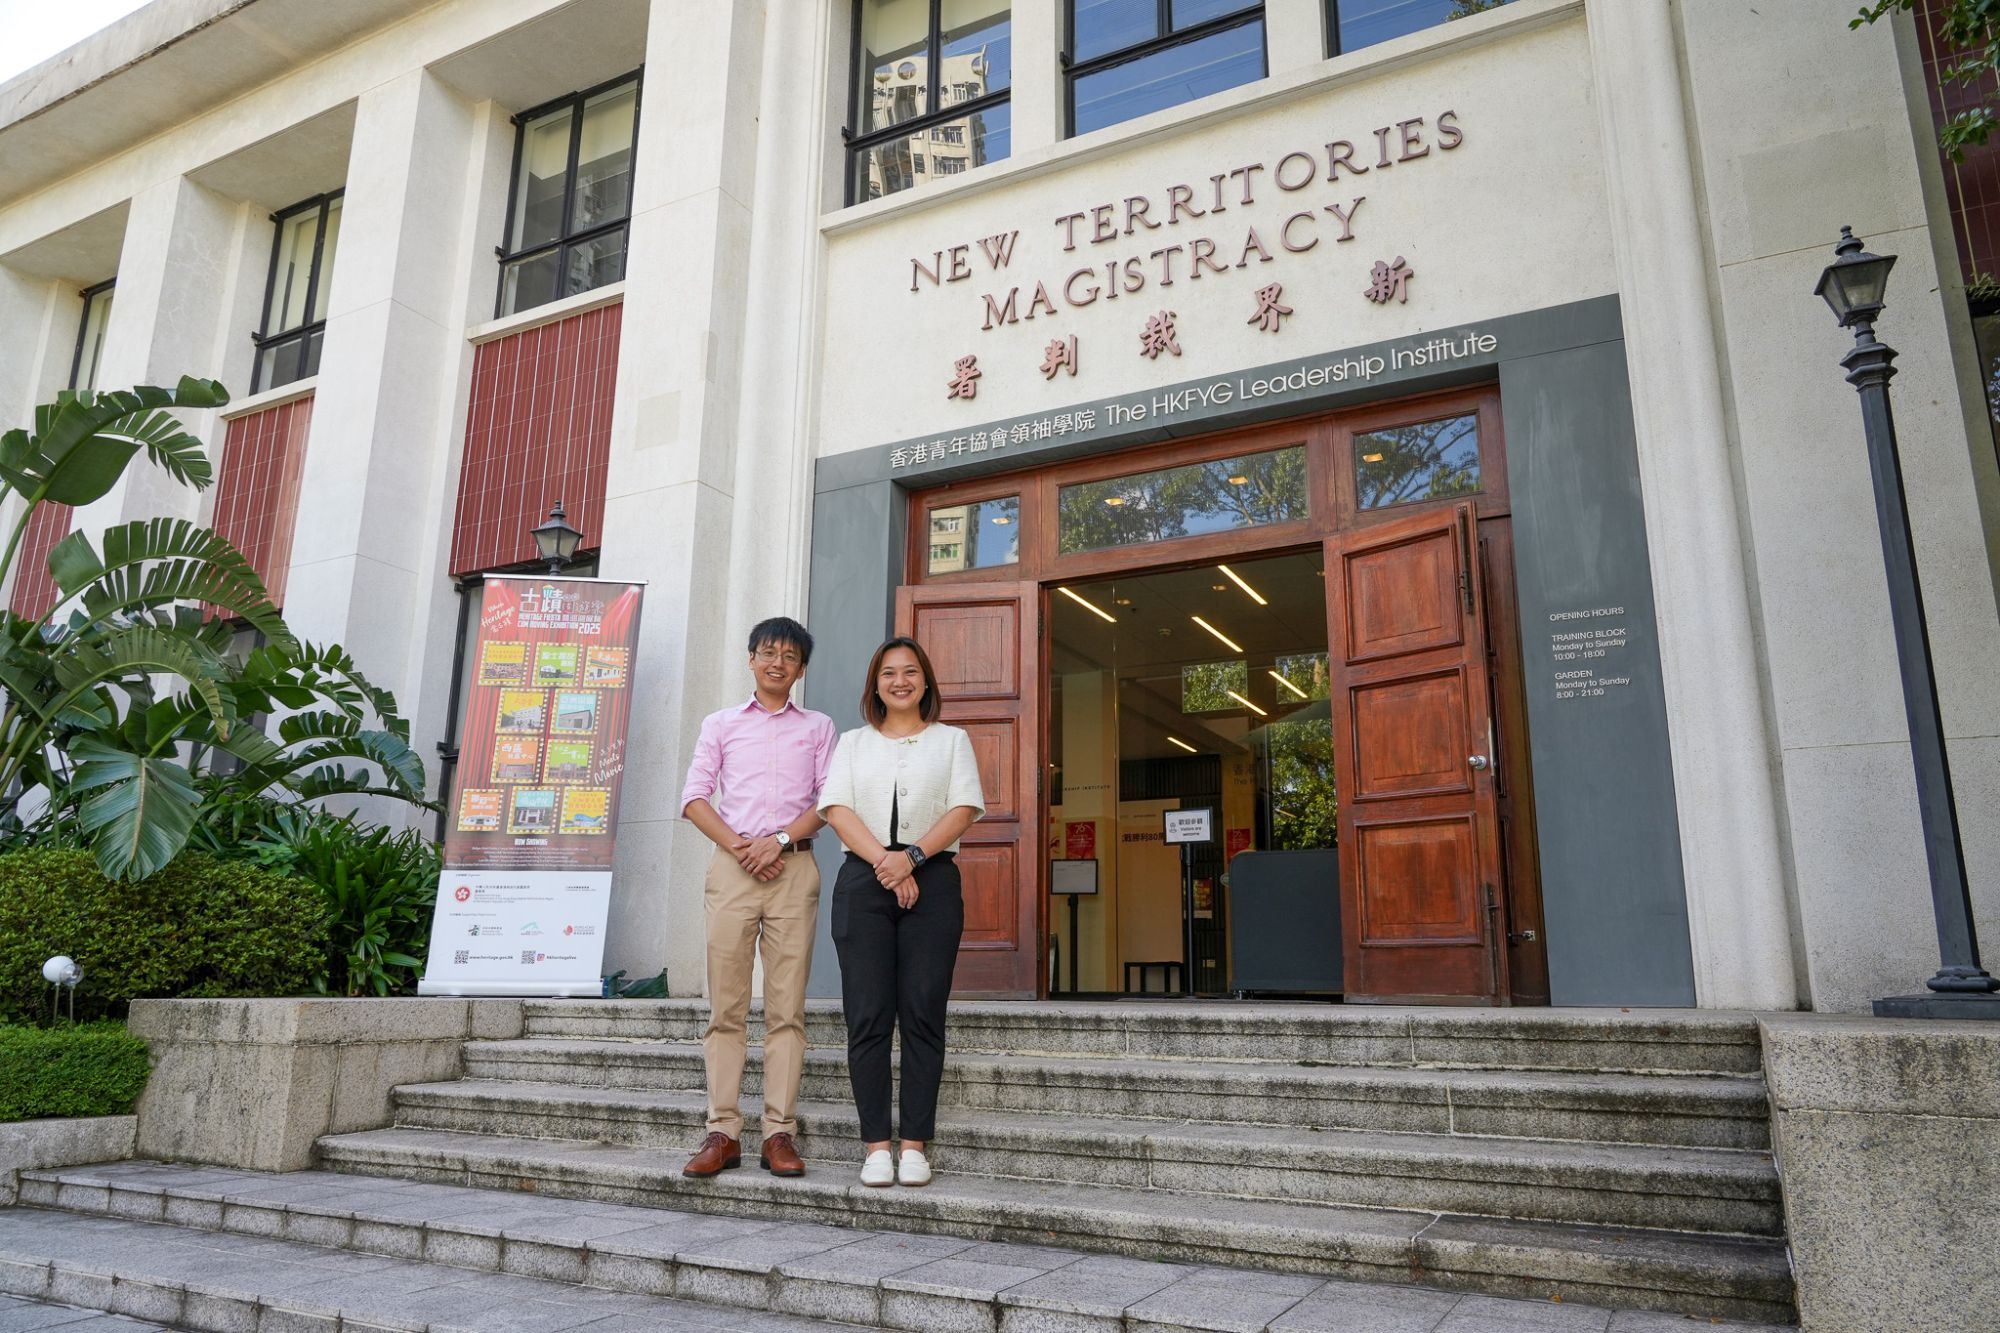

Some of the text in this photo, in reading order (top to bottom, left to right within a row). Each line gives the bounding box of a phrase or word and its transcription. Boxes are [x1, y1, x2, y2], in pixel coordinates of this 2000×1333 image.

[910, 110, 1463, 292] NEW TERRITORIES
[981, 197, 1366, 331] MAGISTRACY
[889, 333, 1497, 469] 香港青年協會領袖學院 The HKFYG Leadership Institute
[481, 606, 515, 627] Heritage
[1549, 606, 1624, 621] OPENING HOURS
[578, 623, 601, 634] 2025
[1551, 628, 1626, 642] TRAINING BLOCK
[1552, 638, 1626, 652] Monday to Sunday
[1554, 652, 1576, 661] 10:00
[1583, 649, 1605, 659] 18:00
[1554, 669, 1593, 680] GARDEN
[1555, 677, 1630, 690] Monday to Sunday
[1556, 690, 1574, 699] 8:00
[1581, 688, 1604, 697] 21:00
[594, 764, 624, 785] Movie
